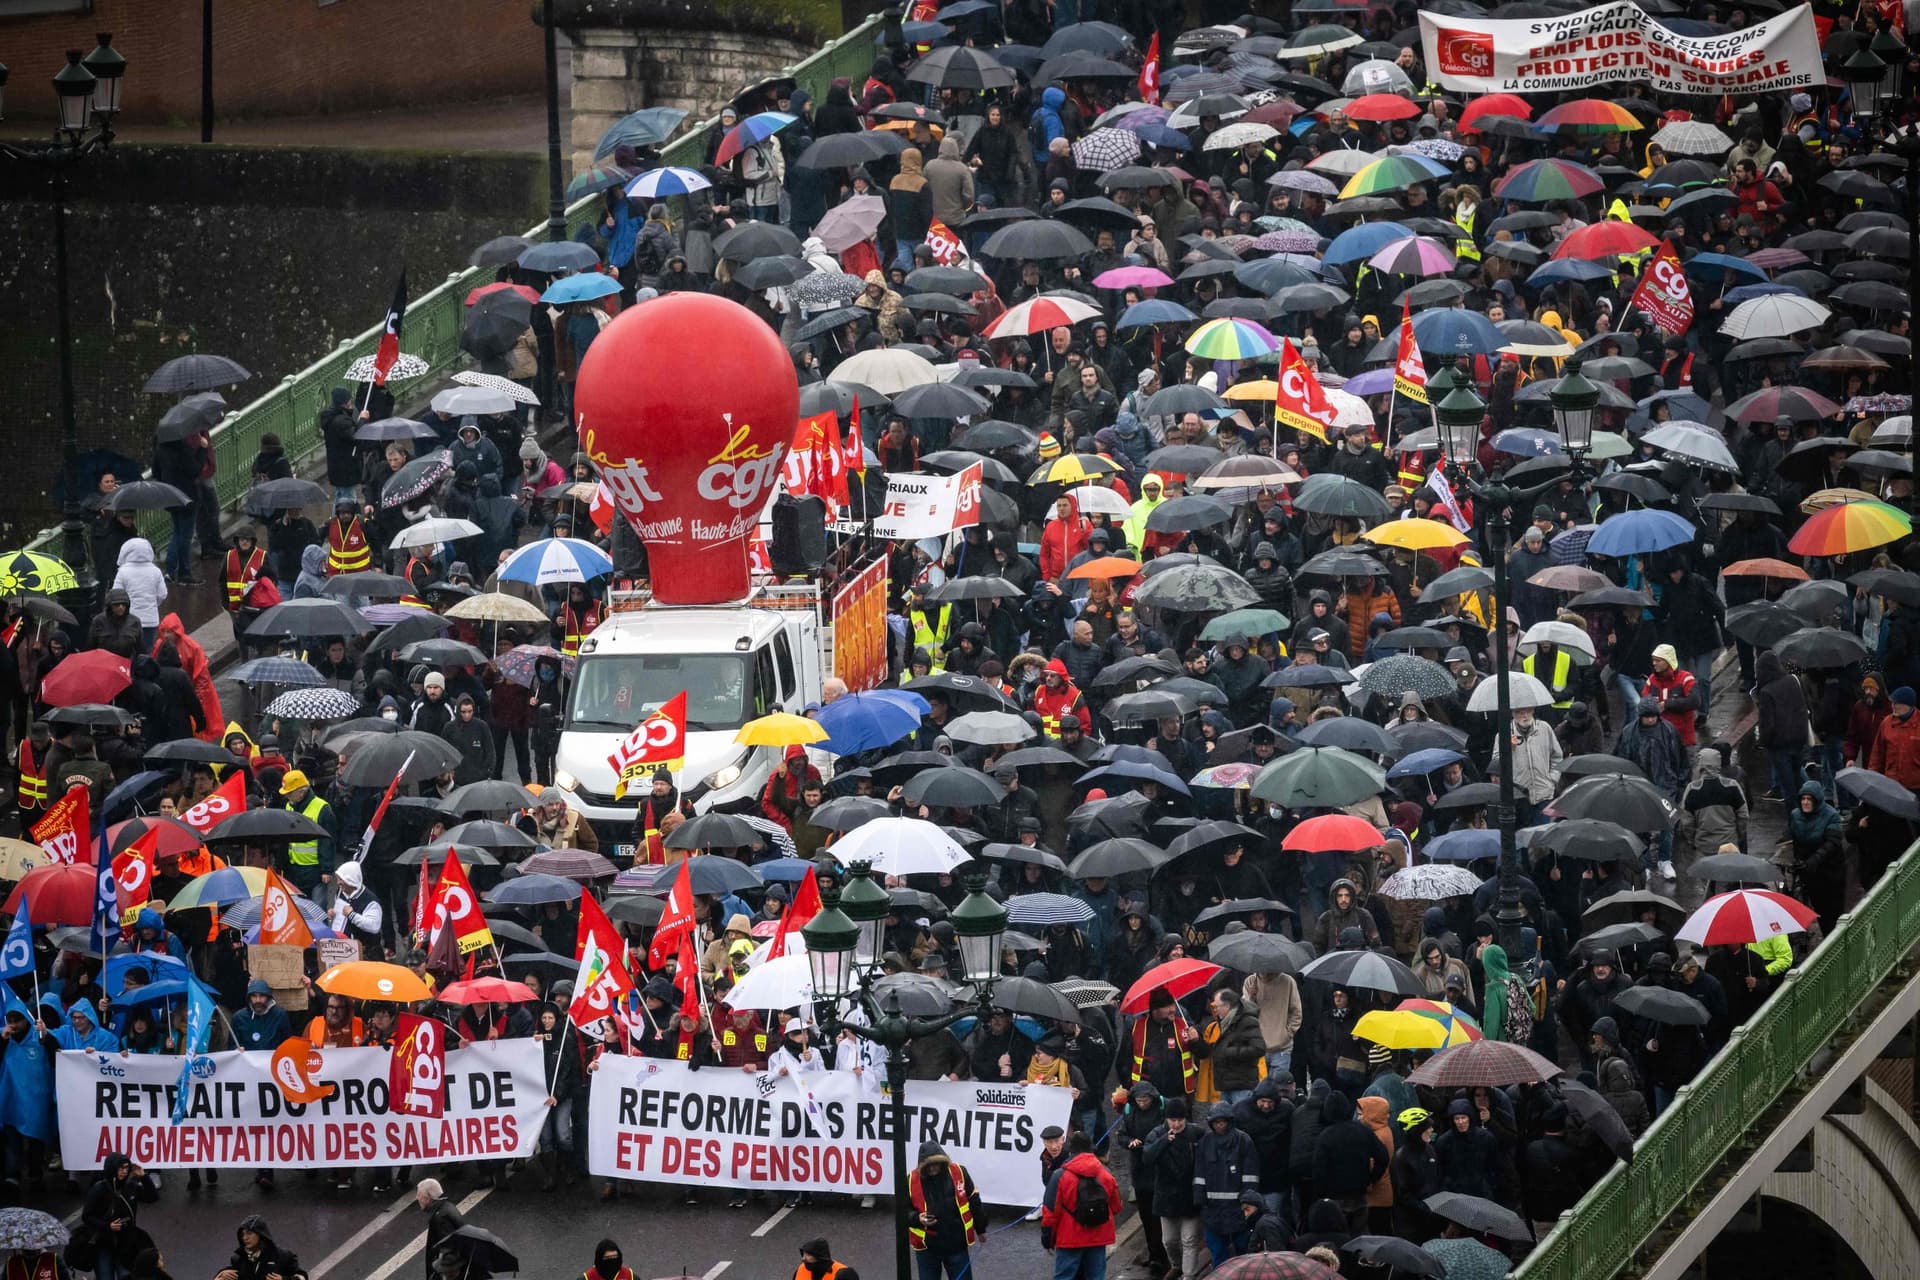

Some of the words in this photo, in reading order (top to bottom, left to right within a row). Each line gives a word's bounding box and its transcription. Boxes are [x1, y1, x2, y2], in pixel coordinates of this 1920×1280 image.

[1529, 6, 1628, 34] SYNDICAT
[1632, 9, 1662, 28] DE
[1670, 26, 1768, 50] TELECOMS
[1555, 27, 1580, 42] DE
[1588, 18, 1647, 34] HAUTE
[1652, 31, 1743, 60] GARONNE
[1461, 53, 1489, 68] cgt
[1517, 51, 1671, 78] PROTECTION
[1682, 60, 1792, 86] SOCIALE
[1648, 43, 1766, 73] SALAIRES
[1503, 79, 1519, 90] LA
[1523, 69, 1627, 90] COMMUNICATION
[1658, 80, 1682, 92] PAS
[1687, 85, 1713, 94] UNE
[1722, 74, 1812, 94] MARCHANDISE
[586, 429, 643, 467] la
[708, 424, 785, 465] la
[591, 458, 663, 514] gt
[697, 441, 785, 508] cgt
[957, 479, 982, 513] cgt
[100, 1065, 126, 1078] cftc
[319, 1074, 456, 1117] PROT
[469, 1071, 516, 1110] DE
[976, 1088, 1026, 1106] Solidaires
[95, 1124, 315, 1164] AUGMENTATION
[325, 1121, 377, 1161] DES
[385, 1114, 519, 1159] SALAIRES
[618, 1086, 772, 1137] REFORME
[856, 1102, 1034, 1153] RETRAITES
[616, 1131, 653, 1172] ET
[661, 1136, 721, 1178] DES
[731, 1142, 883, 1186] PENSIONS
